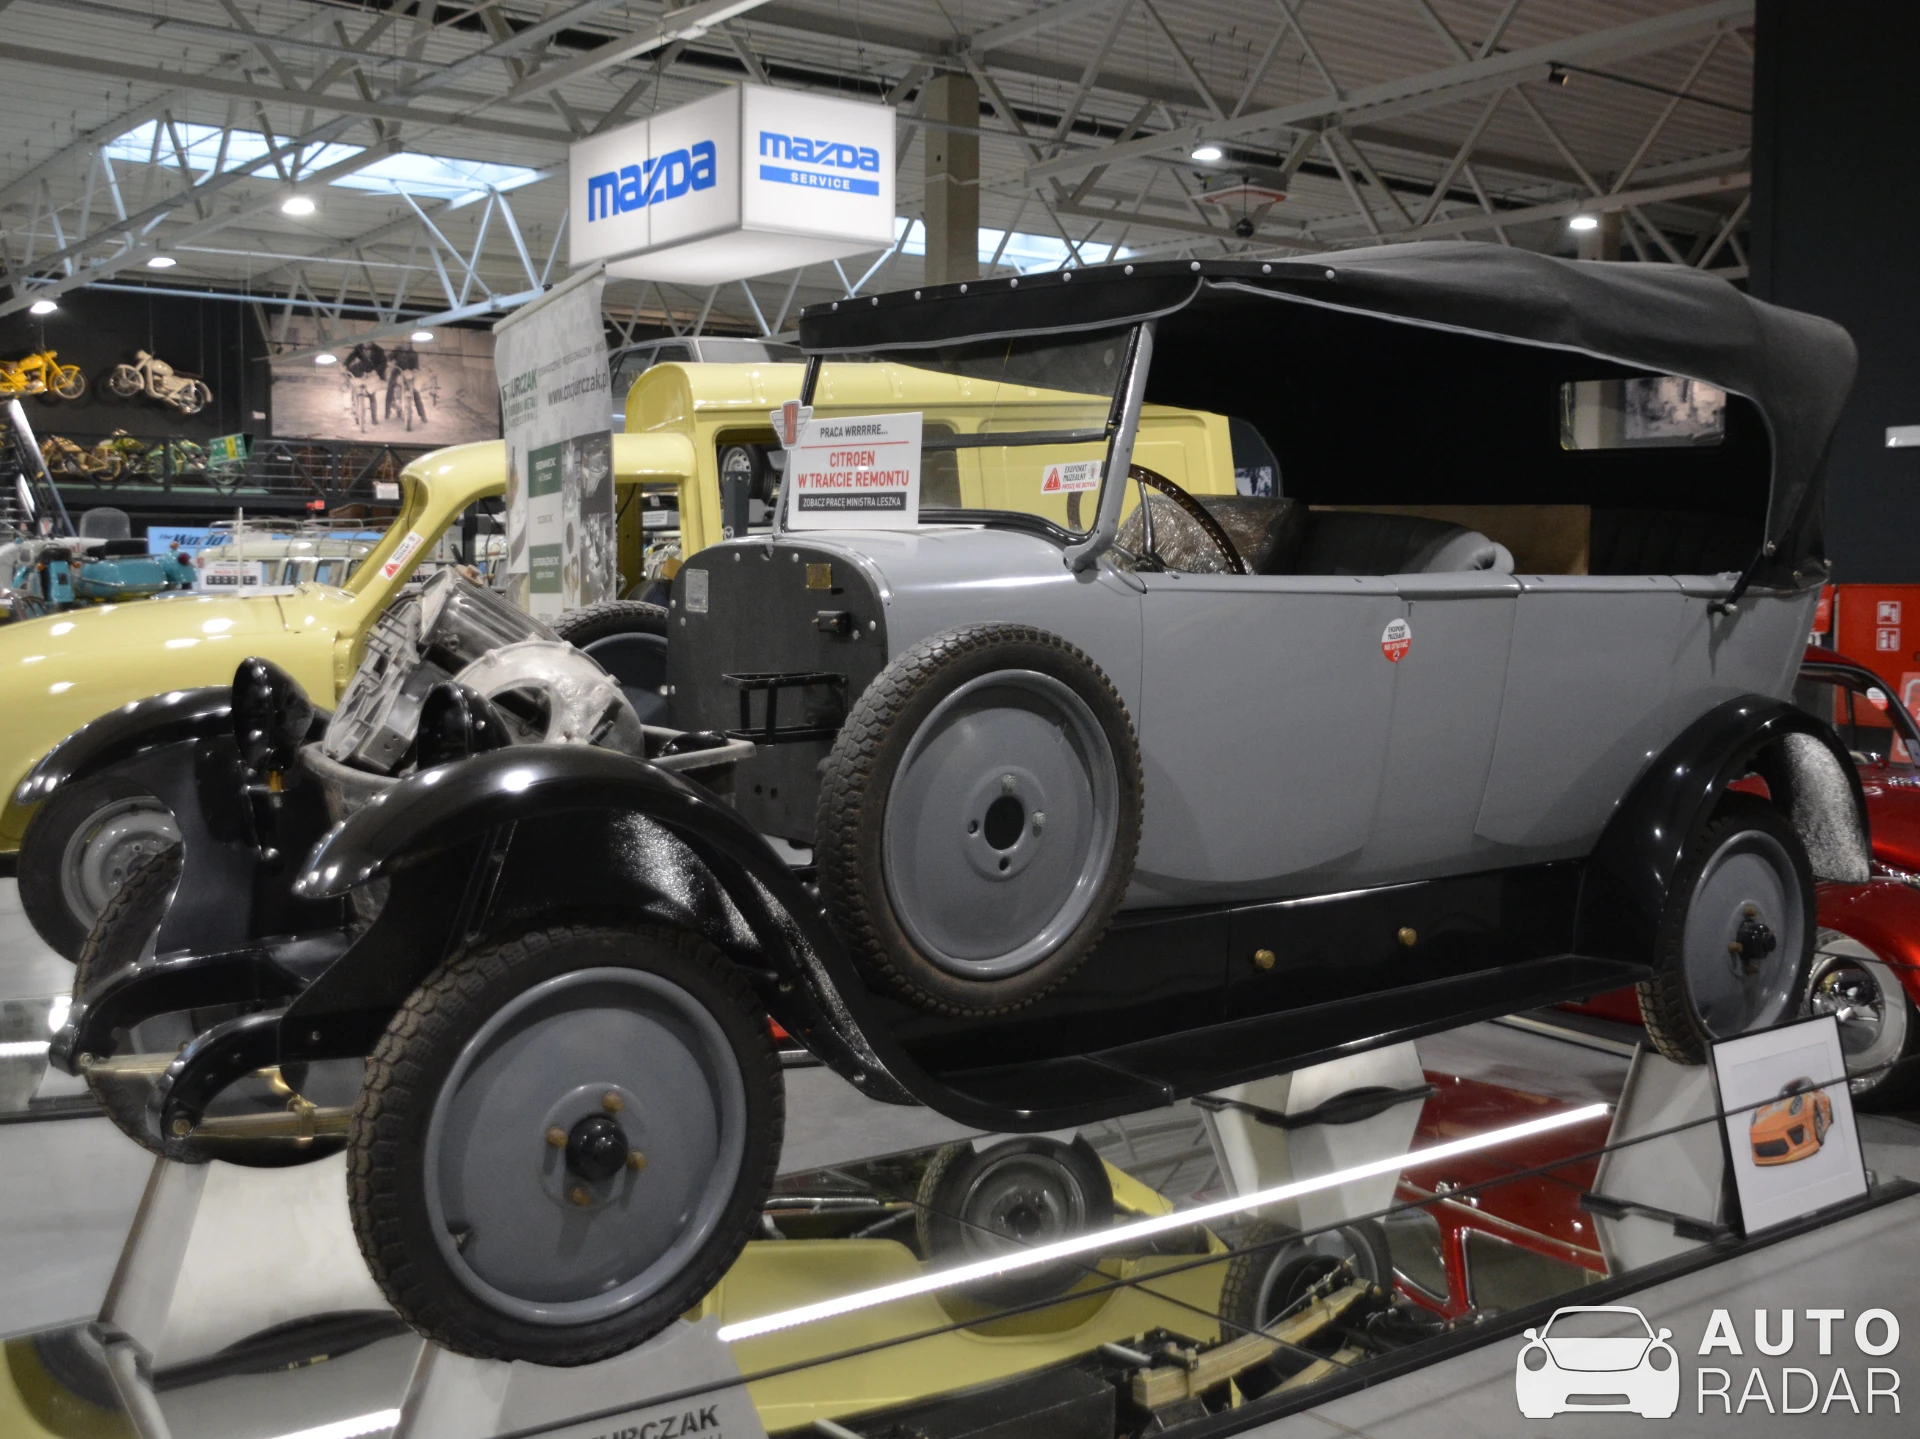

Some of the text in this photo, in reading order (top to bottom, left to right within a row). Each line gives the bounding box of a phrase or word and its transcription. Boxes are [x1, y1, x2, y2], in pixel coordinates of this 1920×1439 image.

[790, 171, 851, 191] SERVICE
[820, 426, 843, 438] PRACA
[829, 450, 876, 468] CITROEN
[798, 470, 909, 488] W TRAKCIE REMONTU
[803, 496, 901, 509] ZOBACZ PRACĘ MINISTRA LESZKA
